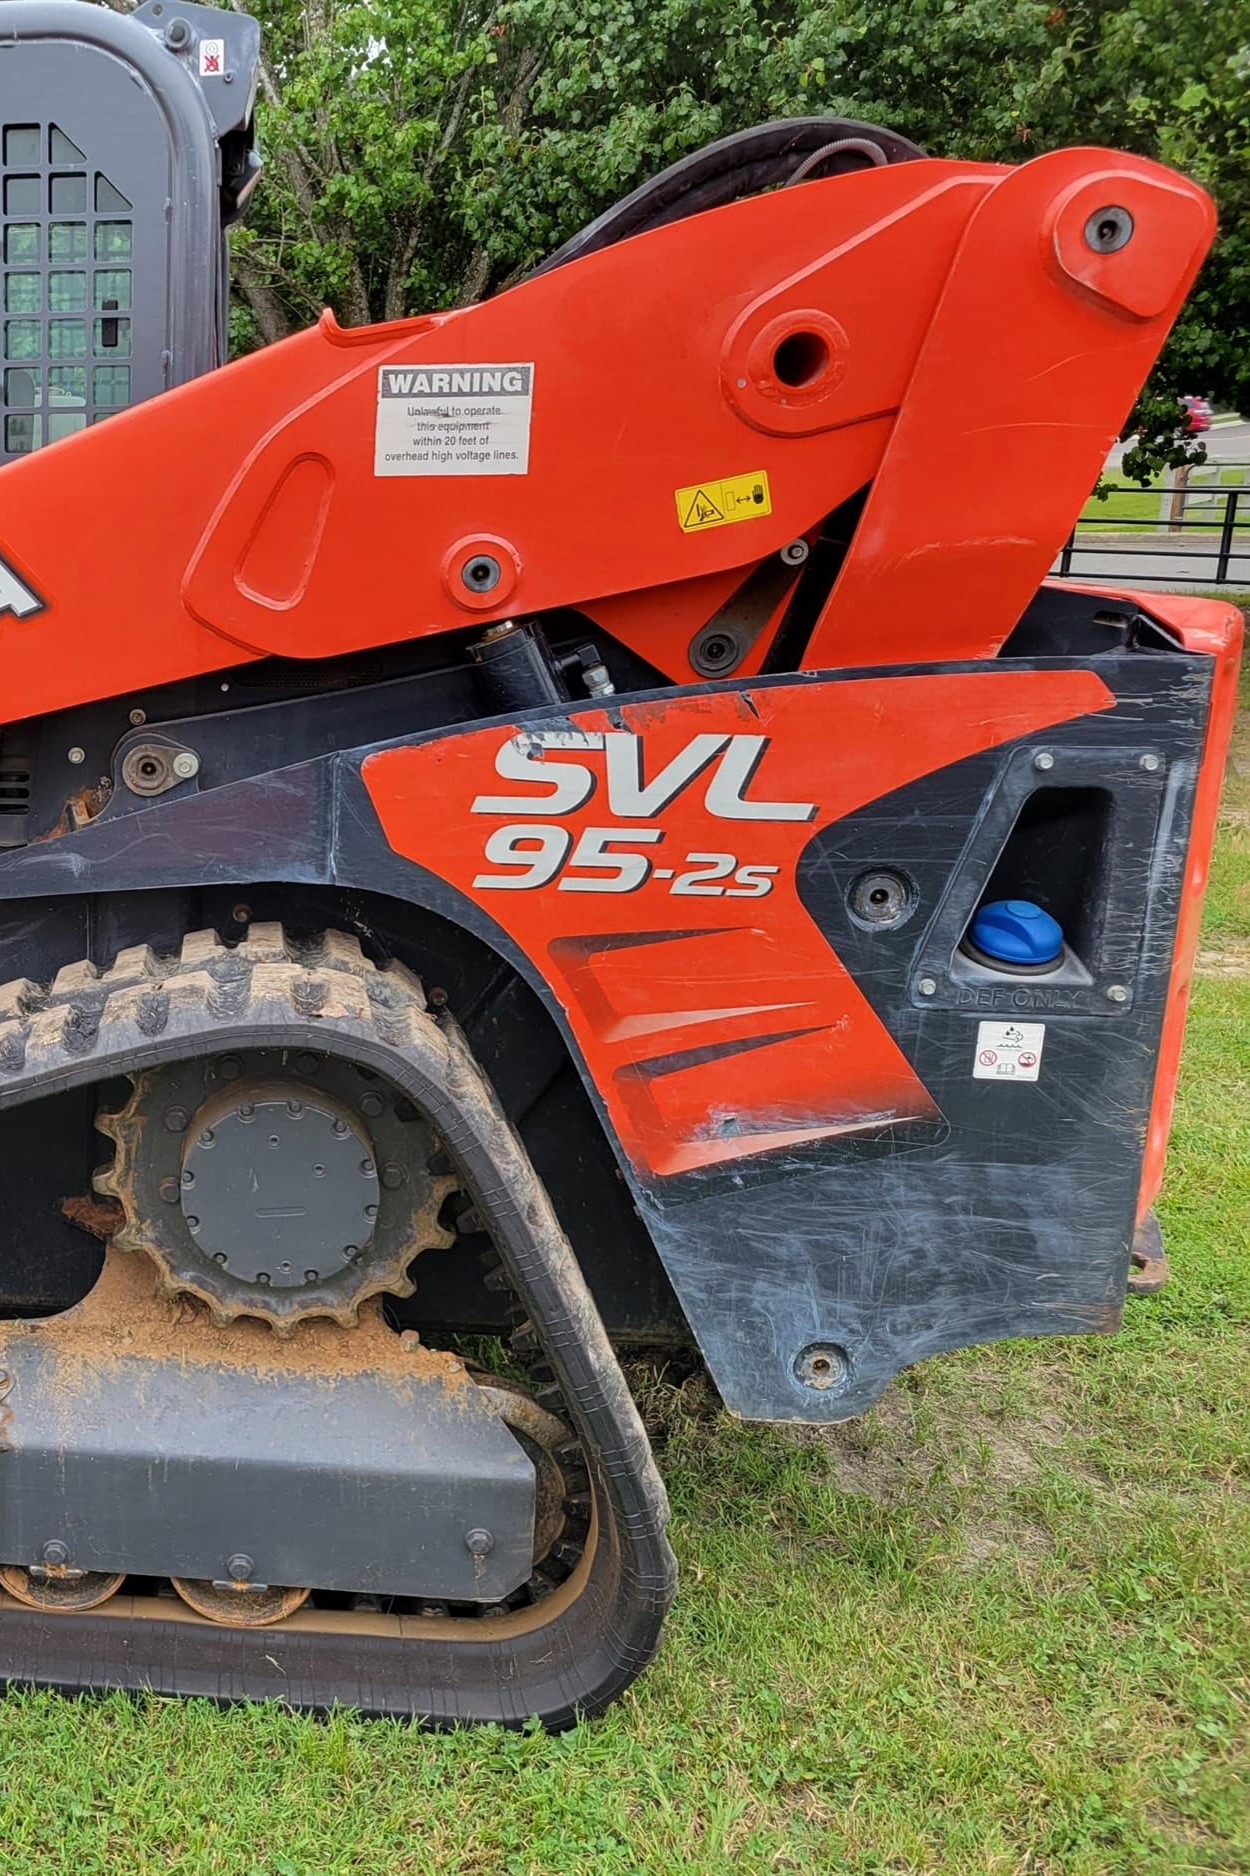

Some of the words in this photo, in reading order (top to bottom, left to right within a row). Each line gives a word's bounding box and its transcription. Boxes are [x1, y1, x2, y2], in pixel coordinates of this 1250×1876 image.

[388, 371, 523, 394] WARNING
[407, 406, 449, 417] Unlawful
[451, 406, 462, 416] to
[463, 405, 501, 418] operate
[417, 422, 436, 432] this
[437, 421, 490, 433] equipment
[413, 436, 442, 446] within
[444, 436, 456, 446] 20
[458, 436, 477, 446] feet
[479, 435, 490, 445] of
[385, 451, 429, 462] overhead
[431, 451, 453, 463] high
[455, 450, 491, 463] voltage
[493, 450, 519, 460] lines.
[470, 732, 818, 821] SVL
[957, 986, 1005, 1007] DEF
[1012, 987, 1086, 1009] ONLY
